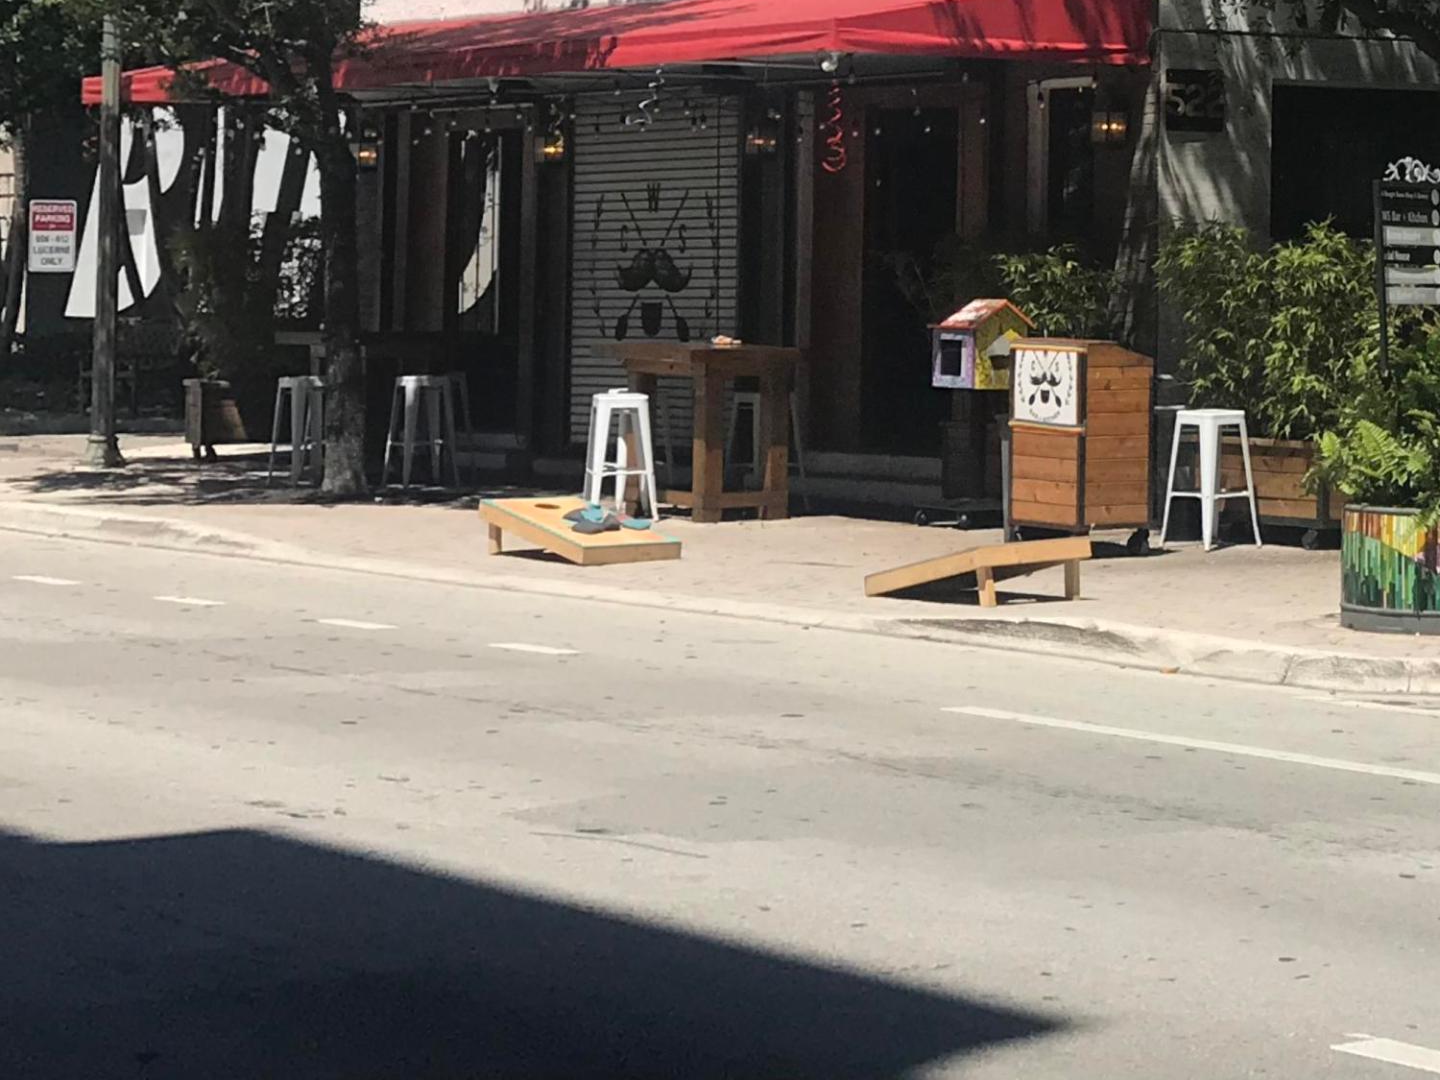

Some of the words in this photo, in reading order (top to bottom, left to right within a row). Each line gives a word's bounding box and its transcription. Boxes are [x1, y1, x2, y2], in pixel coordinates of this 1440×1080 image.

[35, 214, 71, 223] PARKING
[33, 246, 70, 254] LUCERNE
[40, 257, 62, 266] ONLY
